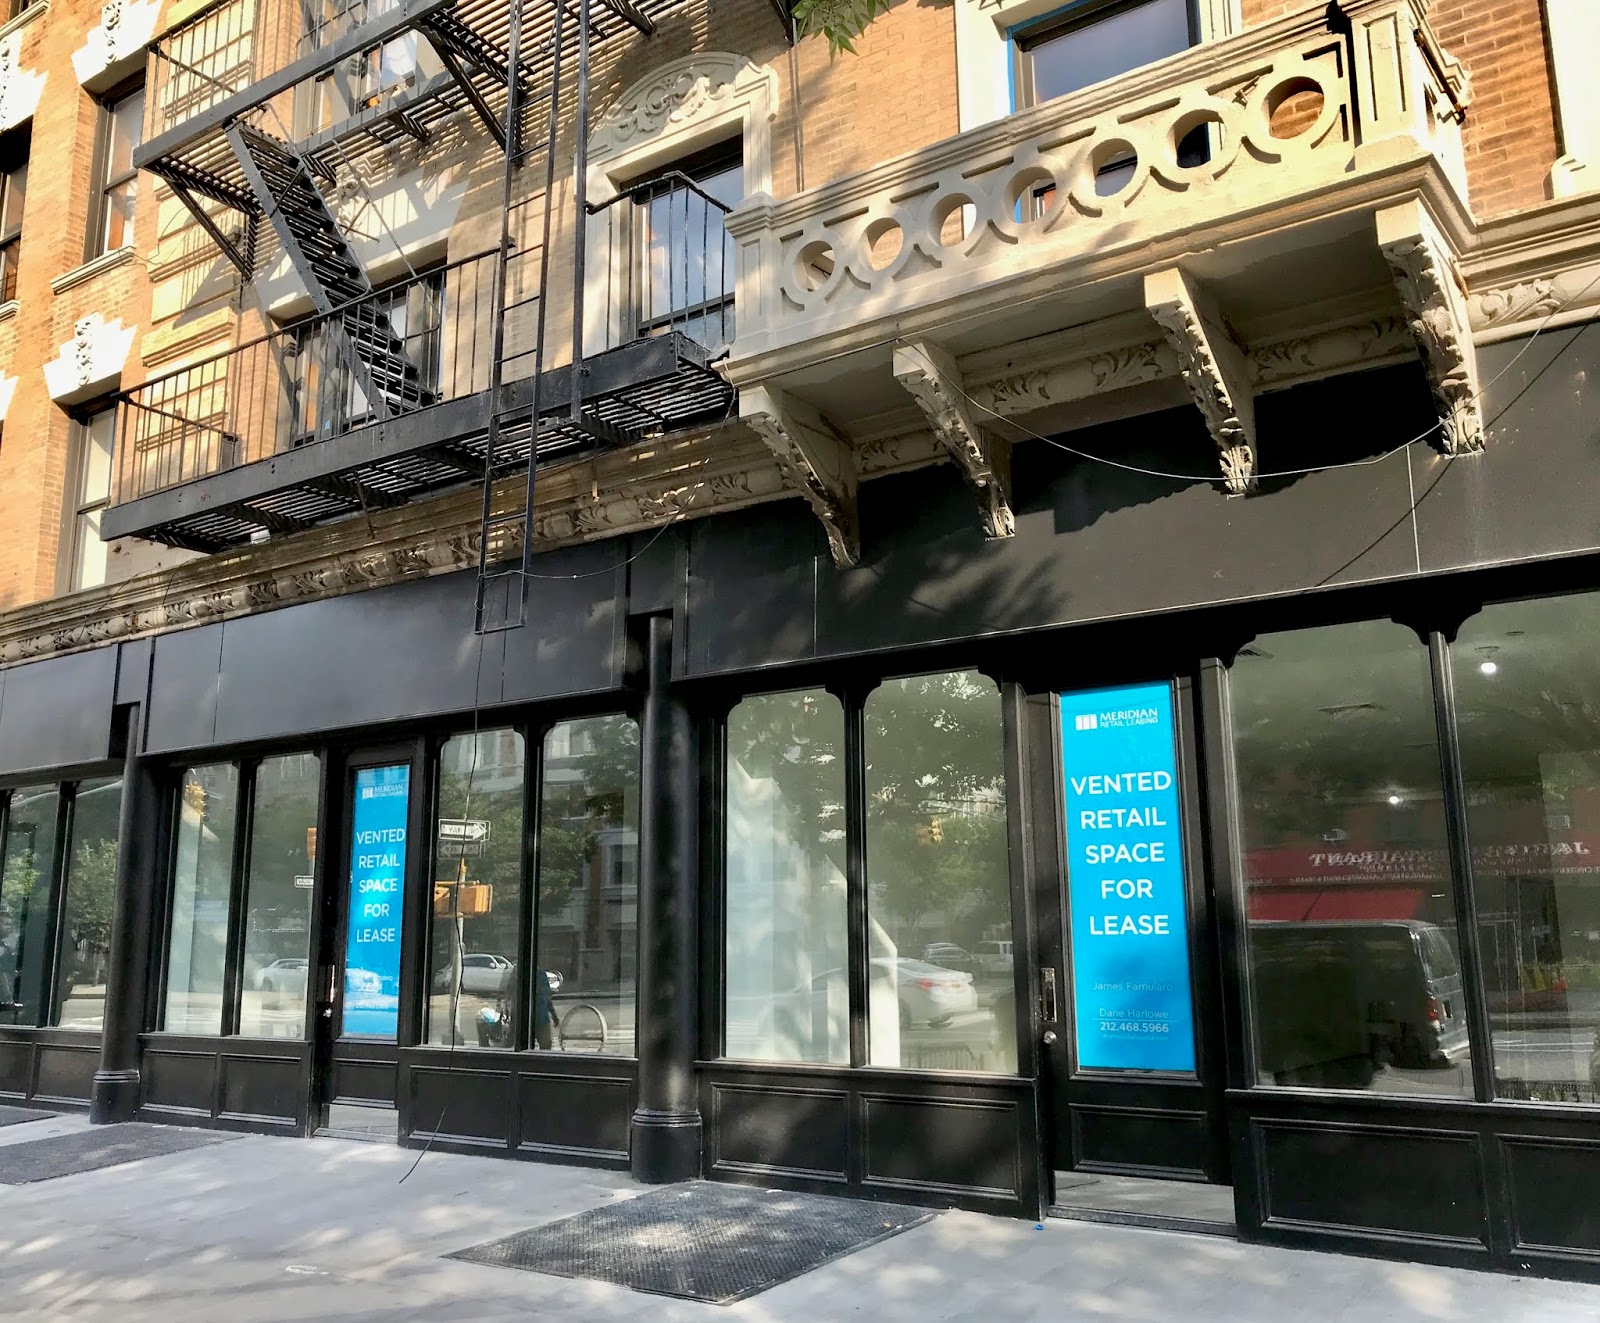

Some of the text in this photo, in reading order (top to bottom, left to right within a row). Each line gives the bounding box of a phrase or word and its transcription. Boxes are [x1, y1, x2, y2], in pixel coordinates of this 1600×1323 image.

[1100, 708, 1158, 722] MERIDIAN
[1100, 717, 1158, 728] RETAIL LEASING
[1071, 770, 1171, 795] VENTED
[1080, 807, 1166, 829] RETAIL
[356, 828, 405, 844] VENTED
[1085, 842, 1165, 864] SPACE
[358, 854, 401, 868] RETAIL
[358, 878, 398, 893] SPACE
[1101, 879, 1153, 899] FOR
[363, 903, 390, 918] FOR
[1089, 914, 1169, 935] LEASE
[356, 928, 395, 943] LEASE
[1093, 982, 1173, 992] James Famularo
[1099, 1008, 1169, 1019] Dane Harlowe
[1100, 1021, 1169, 1033] 212.468.5966
